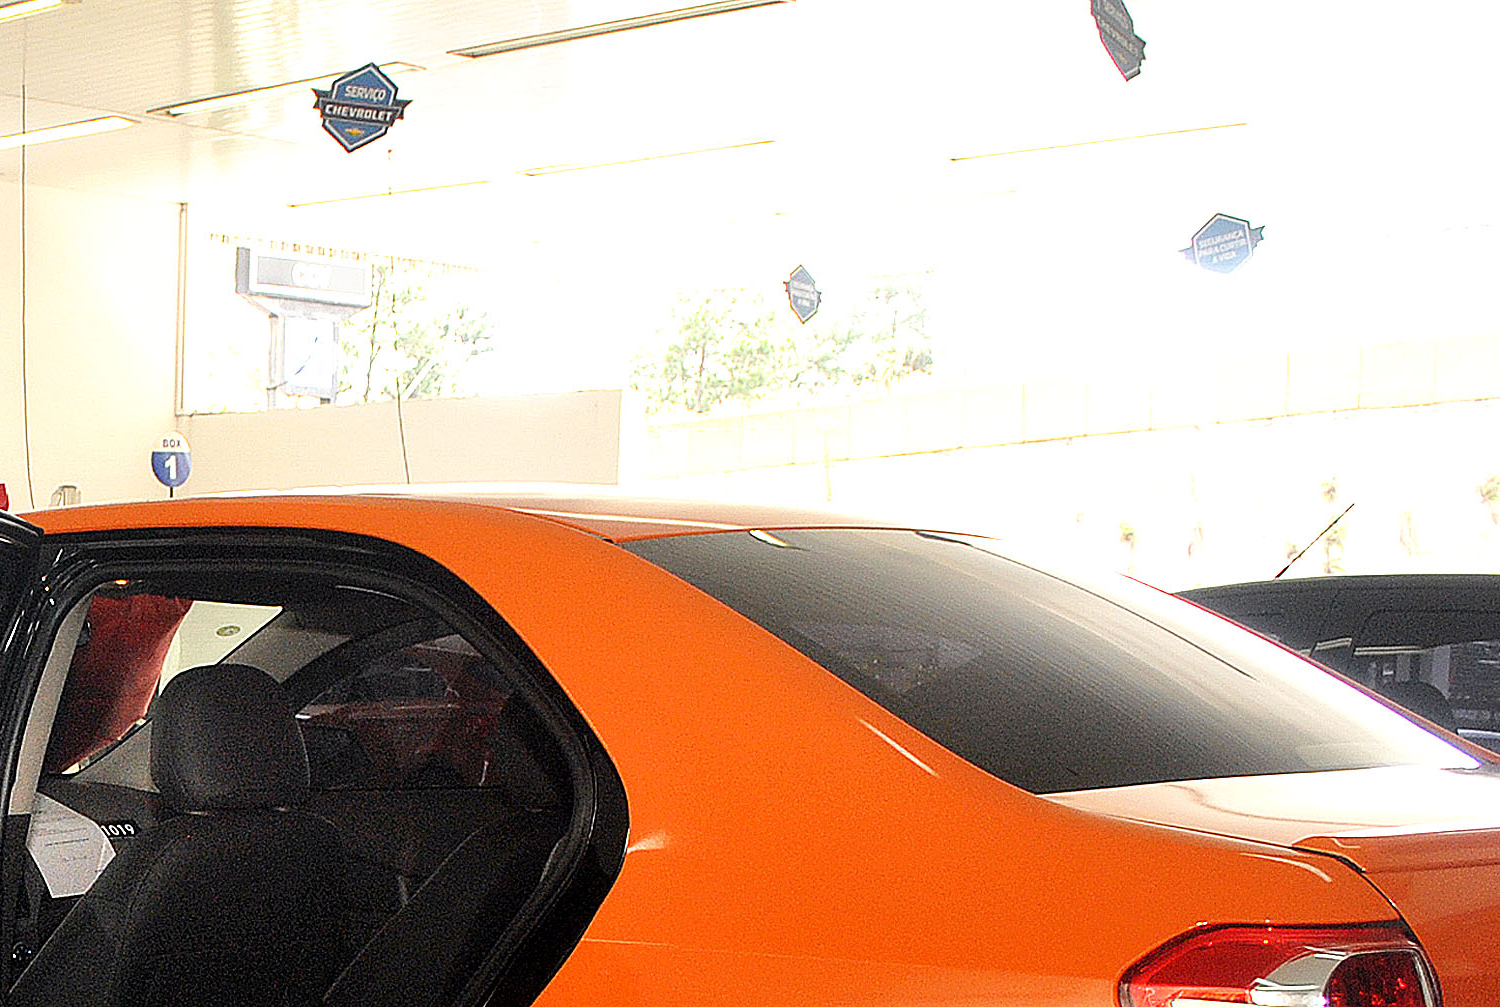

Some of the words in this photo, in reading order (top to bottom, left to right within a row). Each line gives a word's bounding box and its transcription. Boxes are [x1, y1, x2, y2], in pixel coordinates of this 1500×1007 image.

[345, 85, 386, 102] SERVIÇO
[324, 104, 393, 121] CHEVROLET
[165, 455, 177, 480] 1
[101, 824, 135, 836] 1019
